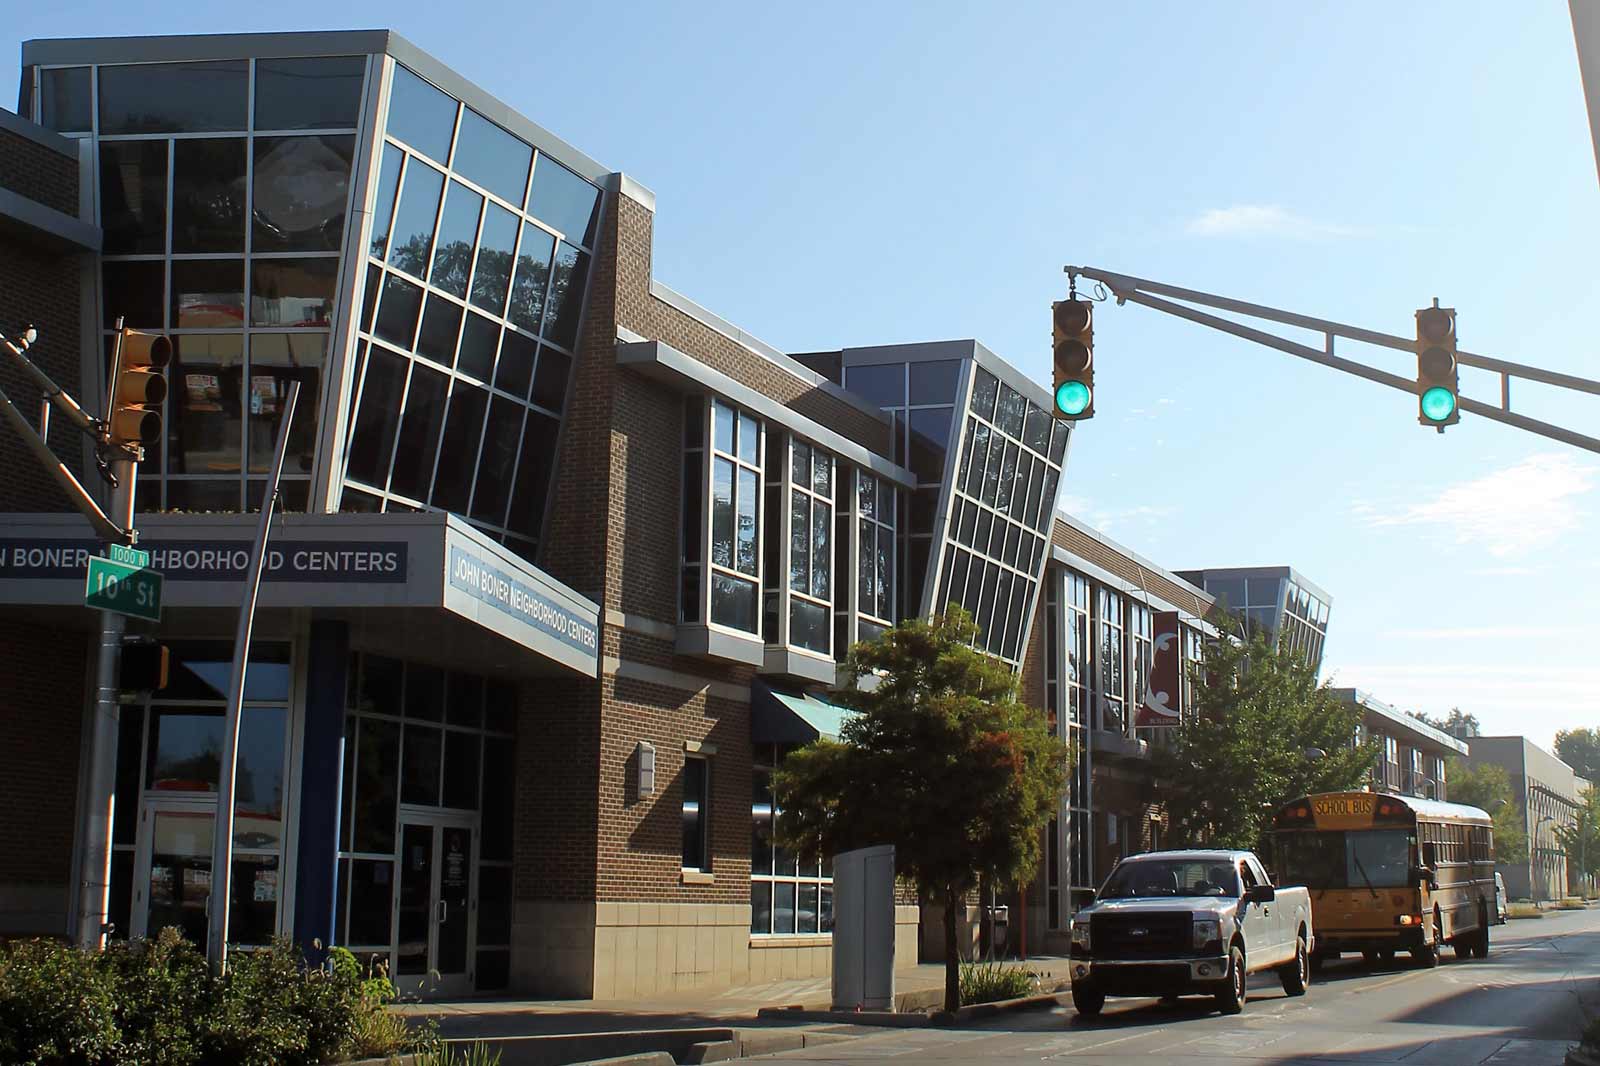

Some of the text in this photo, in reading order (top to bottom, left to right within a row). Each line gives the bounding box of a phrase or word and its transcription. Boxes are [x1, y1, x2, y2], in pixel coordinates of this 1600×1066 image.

[13, 548, 88, 568] BONER
[293, 551, 397, 571] CENTERS
[114, 547, 145, 568] 1000 N
[136, 582, 154, 607] St
[455, 556, 596, 649] JOHN BONER NEIGHBORHOOD CENTERS
[1316, 799, 1372, 815] SCHOOL BUS
